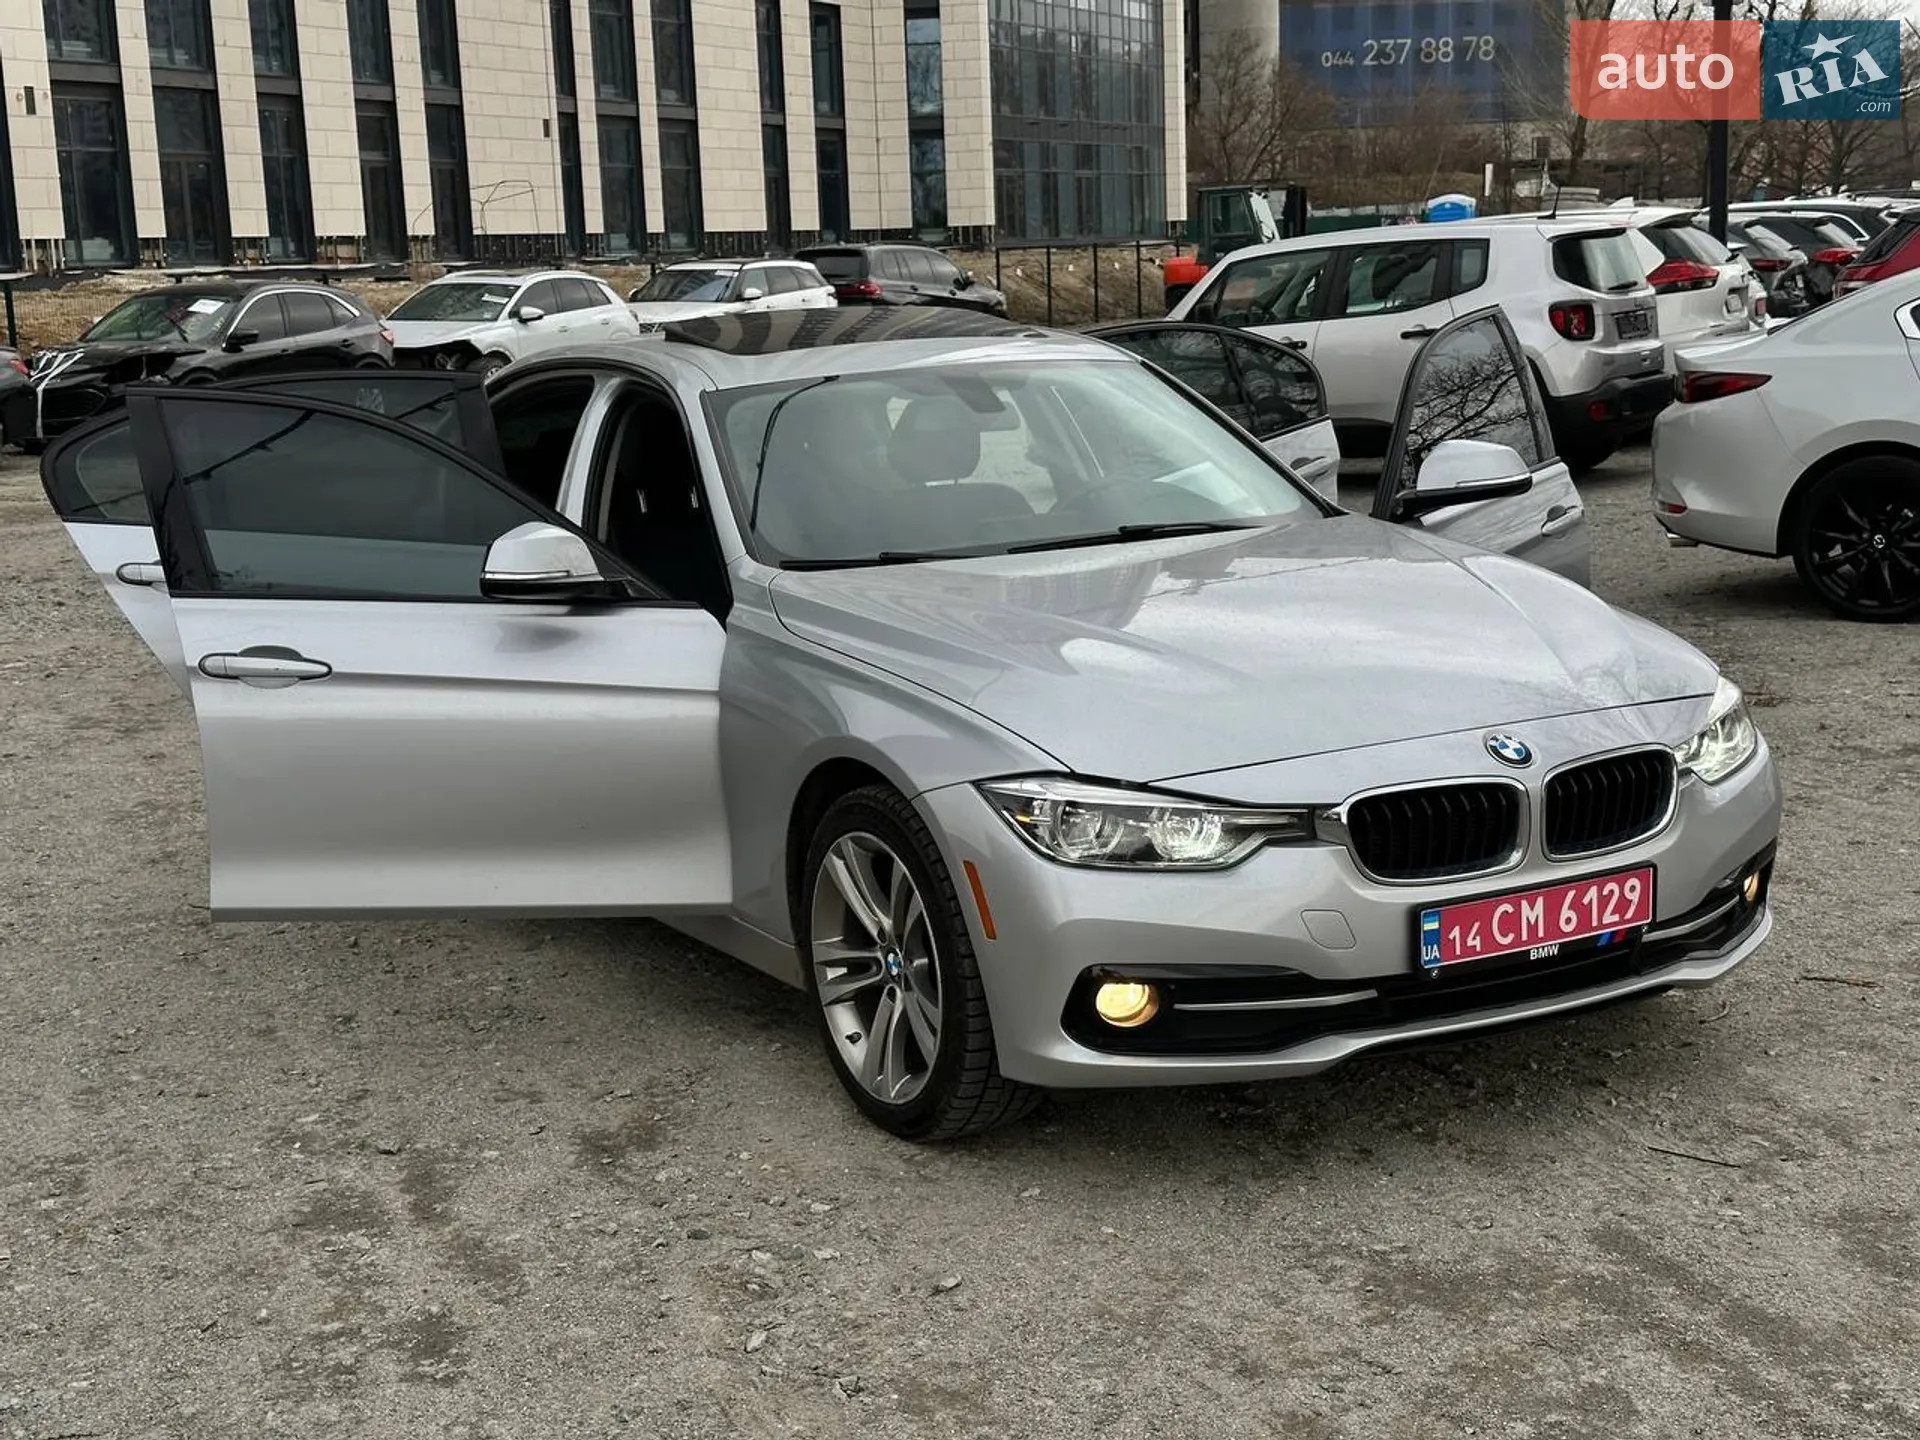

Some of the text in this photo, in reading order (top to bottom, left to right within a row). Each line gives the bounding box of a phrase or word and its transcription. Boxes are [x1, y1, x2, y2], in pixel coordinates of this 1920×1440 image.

[1321, 35, 1495, 67] 044 237 88 78
[1448, 877, 1641, 955] 14 CM 6129
[1423, 944, 1440, 960] UA
[1529, 944, 1560, 960] BMW
